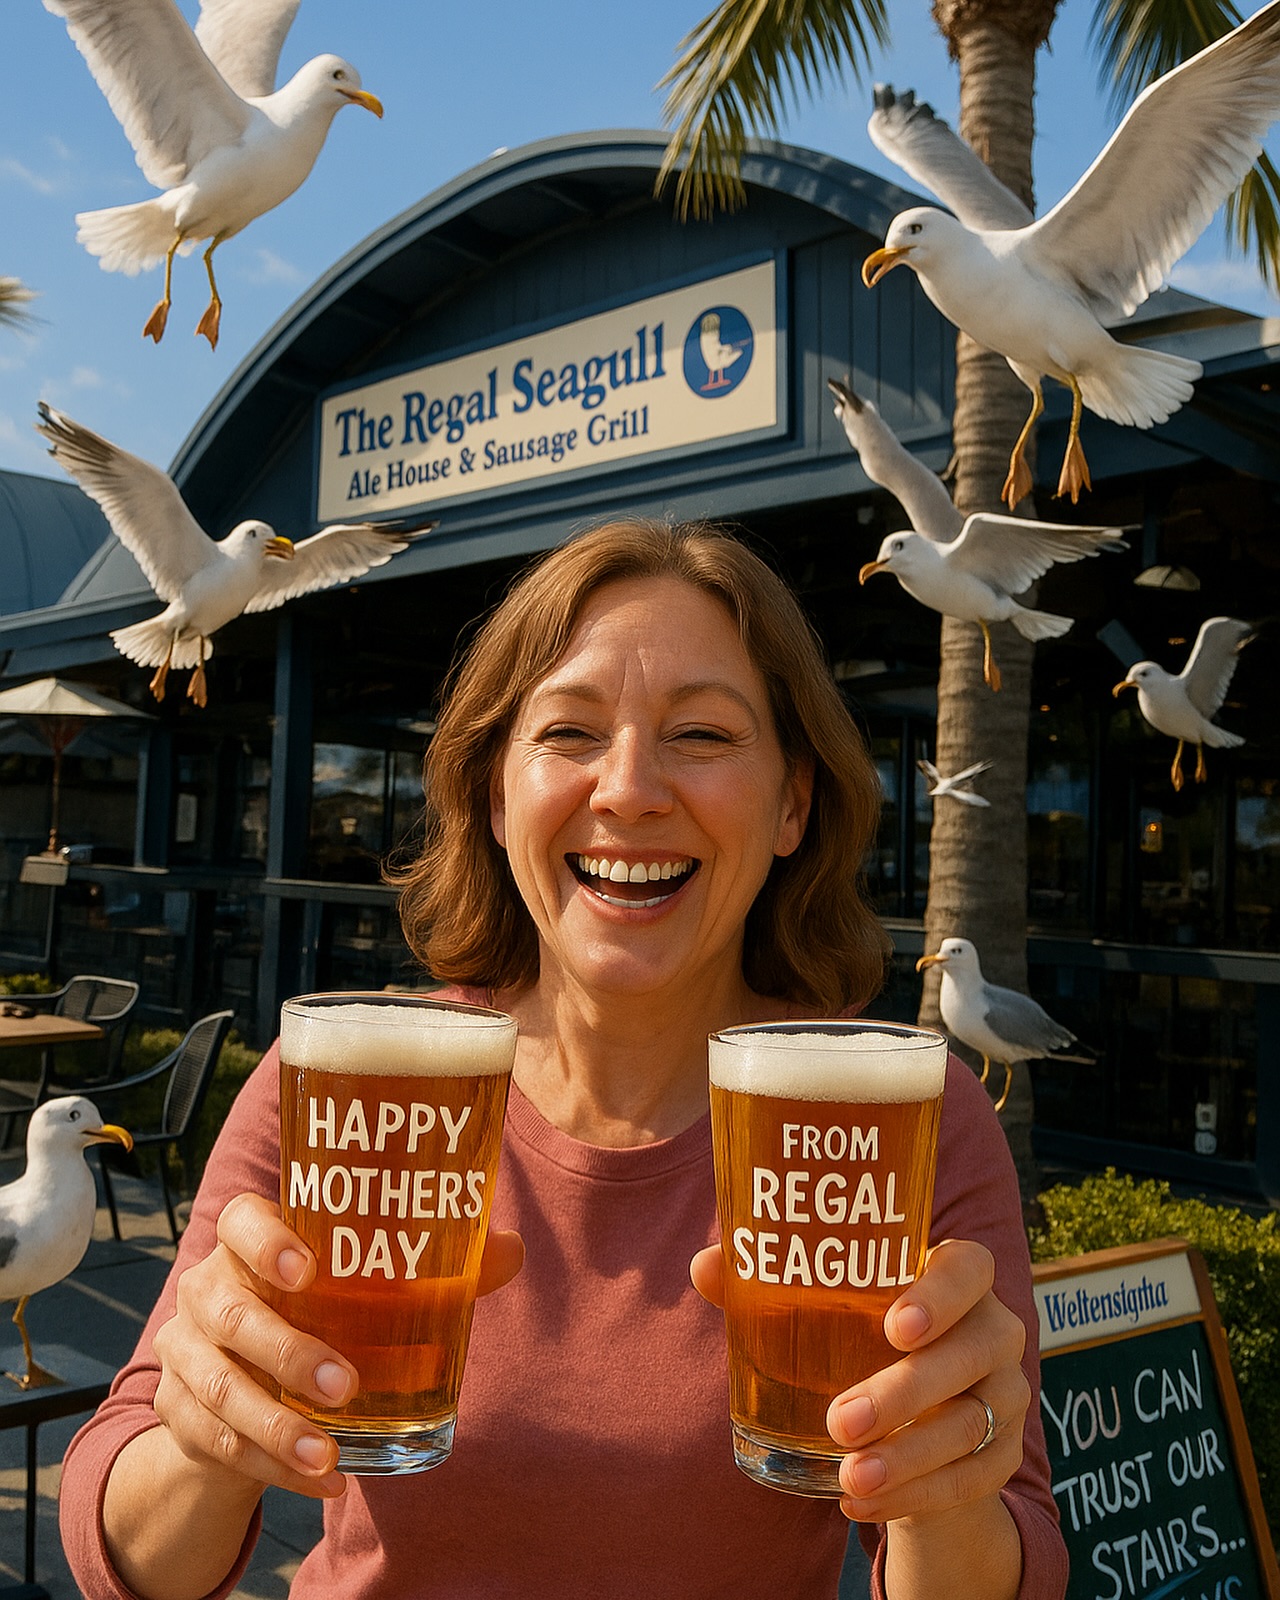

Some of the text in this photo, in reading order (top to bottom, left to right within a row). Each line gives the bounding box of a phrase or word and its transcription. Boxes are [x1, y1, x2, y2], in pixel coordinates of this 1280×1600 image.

[335, 321, 667, 457] The Regal Seagull
[347, 405, 649, 500] Ale House & Sausage Grill
[308, 1096, 472, 1154] HAPPY
[782, 1122, 880, 1162] FROM
[753, 1166, 906, 1225] REGAL
[331, 1225, 432, 1280] DAY
[733, 1226, 916, 1288] SEAGULL
[1039, 1348, 1204, 1458] YOU CAN
[1051, 1427, 1227, 1533] TRUST OUR
[1091, 1504, 1247, 1600] STAIRS...
